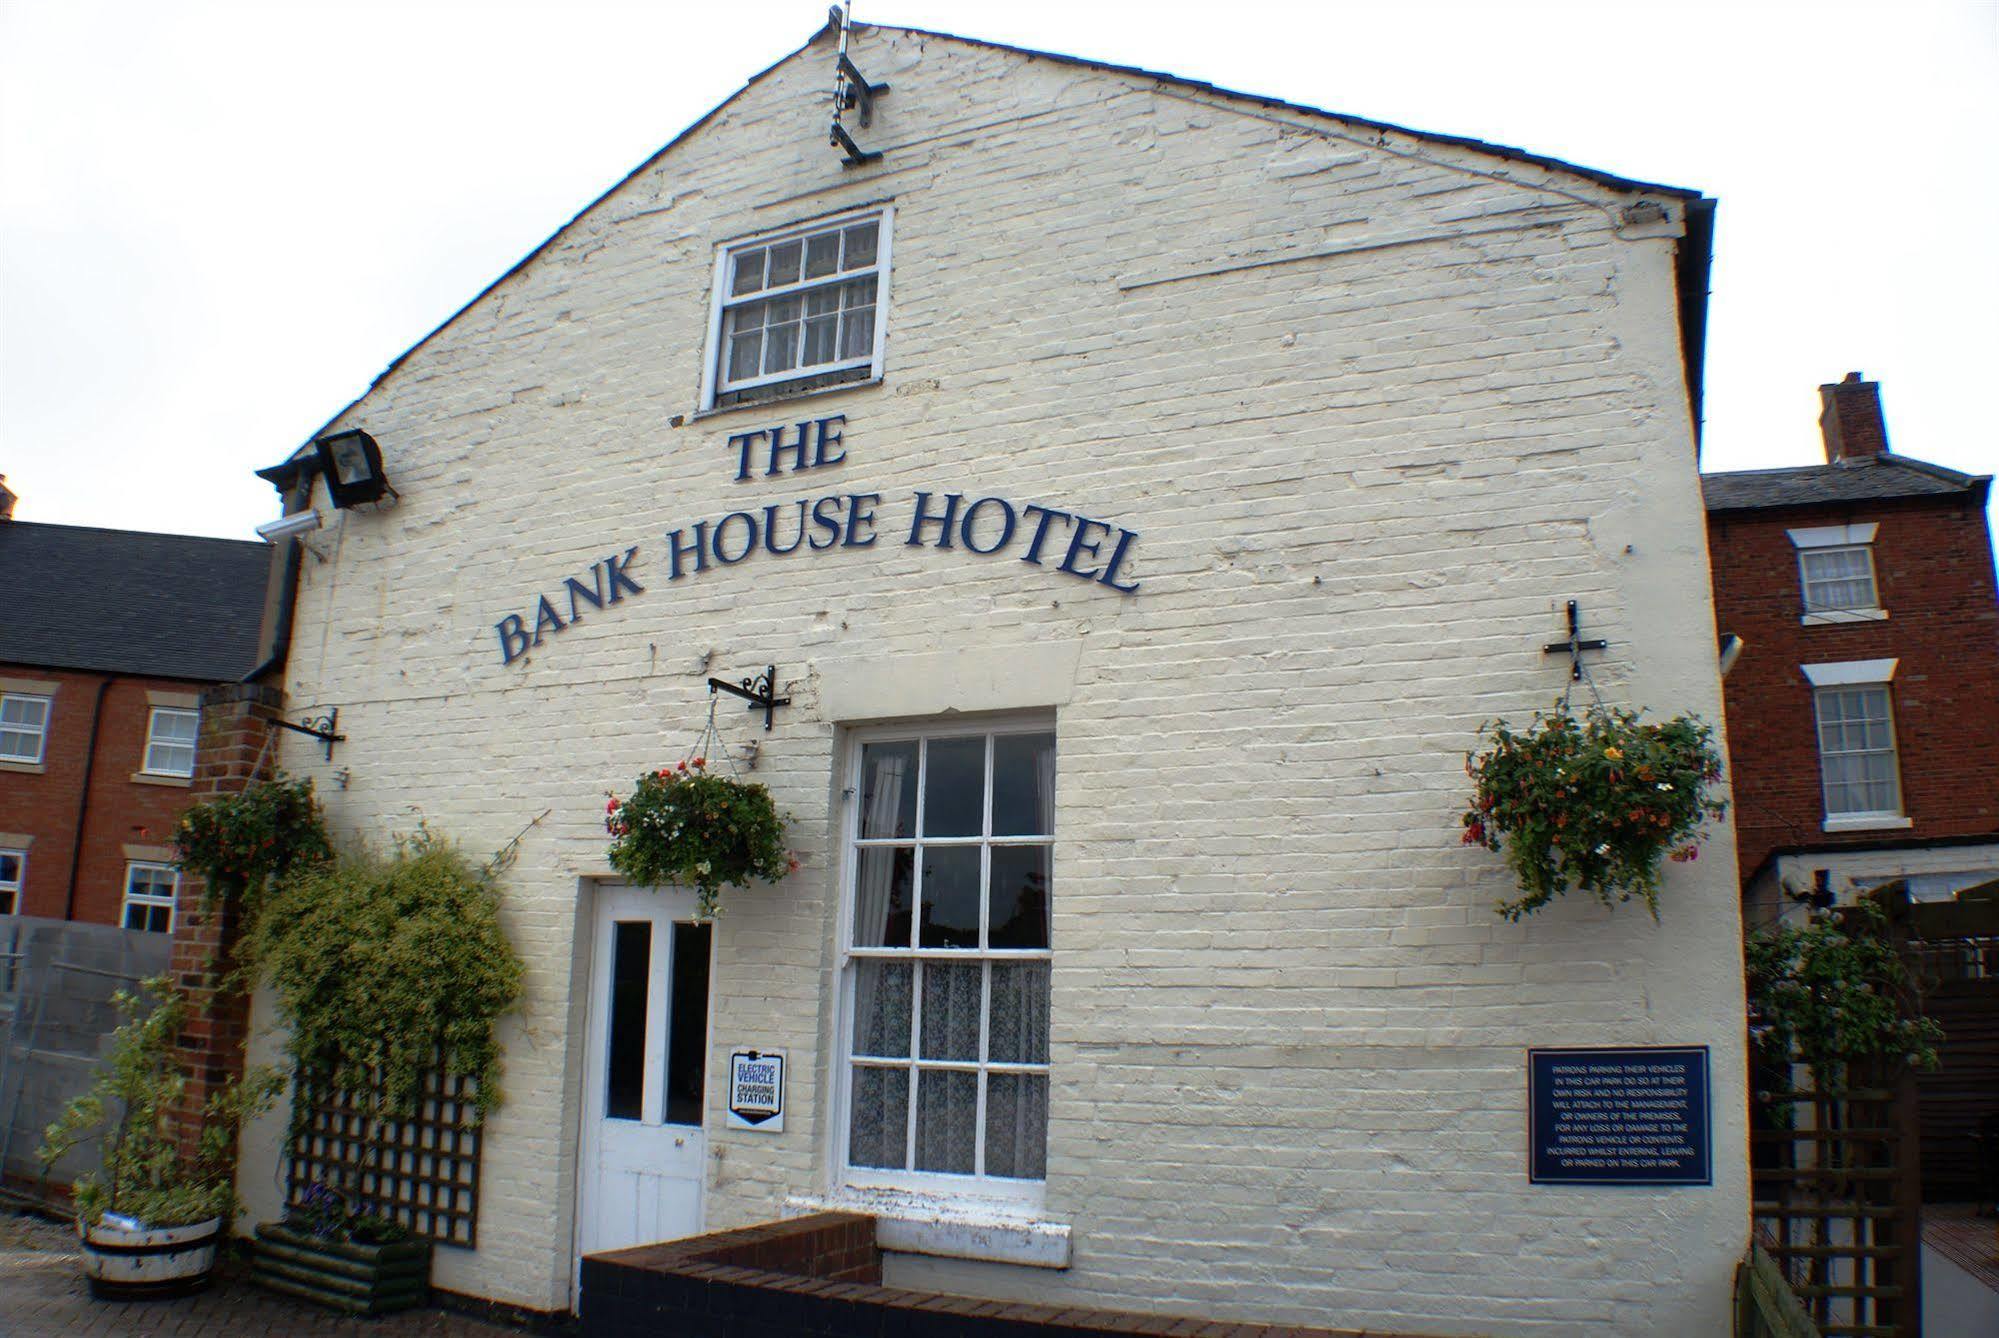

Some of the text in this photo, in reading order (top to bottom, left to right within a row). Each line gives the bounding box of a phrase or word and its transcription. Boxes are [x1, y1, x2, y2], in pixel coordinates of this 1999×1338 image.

[728, 414, 848, 482] THE
[494, 491, 1141, 666] BANK HOUSE HOTEL
[738, 1063, 775, 1073] ELECTRIC
[1589, 1064, 1622, 1074] PARKING
[1624, 1064, 1646, 1074] THEIR
[1648, 1064, 1685, 1074] VEHICLES
[738, 1072, 775, 1084] VEHICLE
[1555, 1076, 1685, 1086] IN THIS CAR PARK DO SO AT THEIR
[737, 1084, 775, 1095] CHARGING
[1553, 1088, 1688, 1097] OWN RISK AND NO RESPONSIBILITY
[737, 1094, 774, 1105] STATION
[1553, 1099, 1570, 1109] WILL
[1603, 1099, 1613, 1109] TO
[1615, 1099, 1629, 1109] THE
[1561, 1111, 1573, 1120] OR
[1575, 1111, 1608, 1120] OWNERS
[1610, 1111, 1621, 1120] OF
[1623, 1111, 1637, 1120] THE
[1555, 1123, 1687, 1132] FOR ANY LOSS OR DAMAGE TO THE
[1595, 1134, 1627, 1144] VEHICLE
[1629, 1134, 1641, 1144] OR
[1547, 1146, 1586, 1156] INCURRED
[1588, 1146, 1617, 1156] WHILST
[1661, 1146, 1695, 1156] LEAVING
[1561, 1158, 1573, 1167] OR
[1575, 1158, 1605, 1167] PARKED
[1607, 1158, 1619, 1167] ON
[1621, 1158, 1638, 1167] THIS
[1640, 1158, 1656, 1167] CAR
